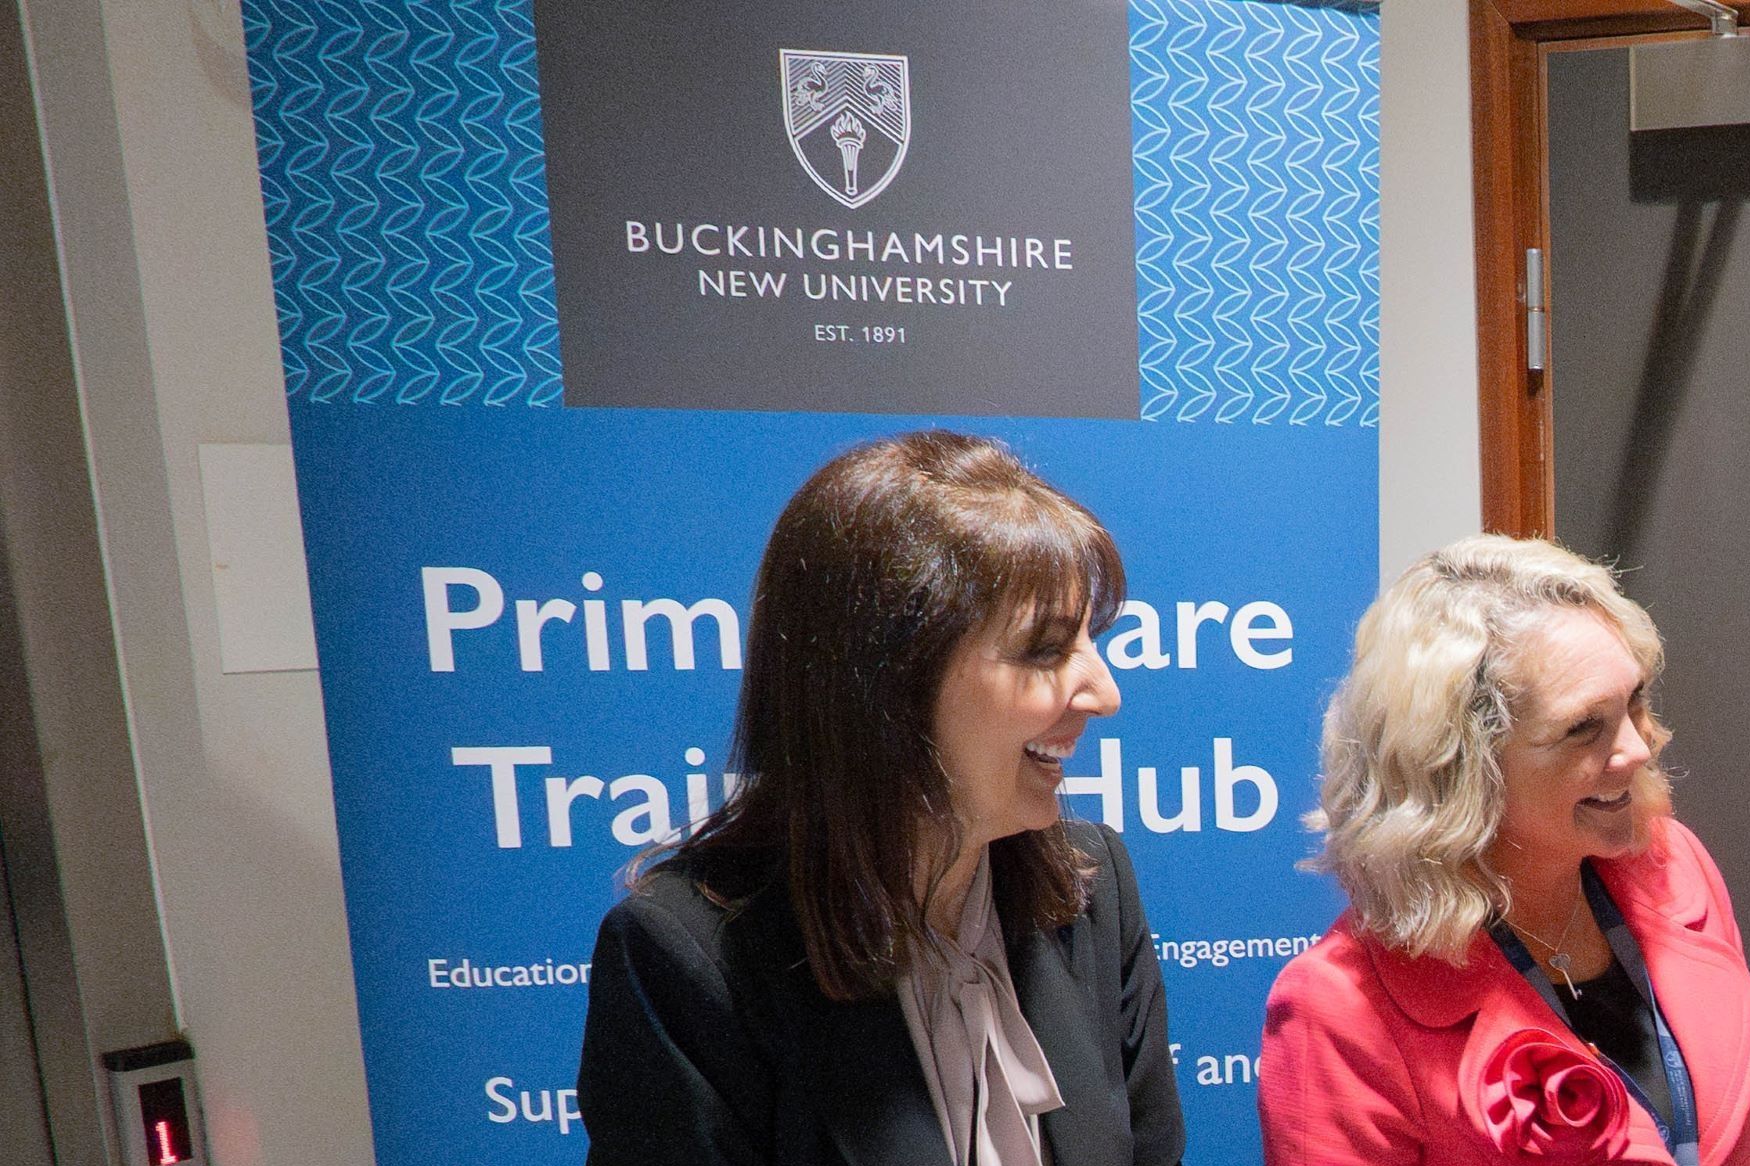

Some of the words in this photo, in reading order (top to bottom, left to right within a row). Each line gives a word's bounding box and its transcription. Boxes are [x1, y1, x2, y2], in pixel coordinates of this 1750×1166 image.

[626, 221, 1074, 270] BUCKINGHAMSHIRE
[699, 270, 787, 298] NEW
[803, 273, 1013, 306] UNIVERSITY
[814, 324, 853, 342] EST.
[862, 326, 905, 343] 1891
[421, 566, 742, 672] Prim
[1092, 600, 1294, 670] are
[1197, 1053, 1260, 1085] an
[155, 1121, 178, 1166] 1
